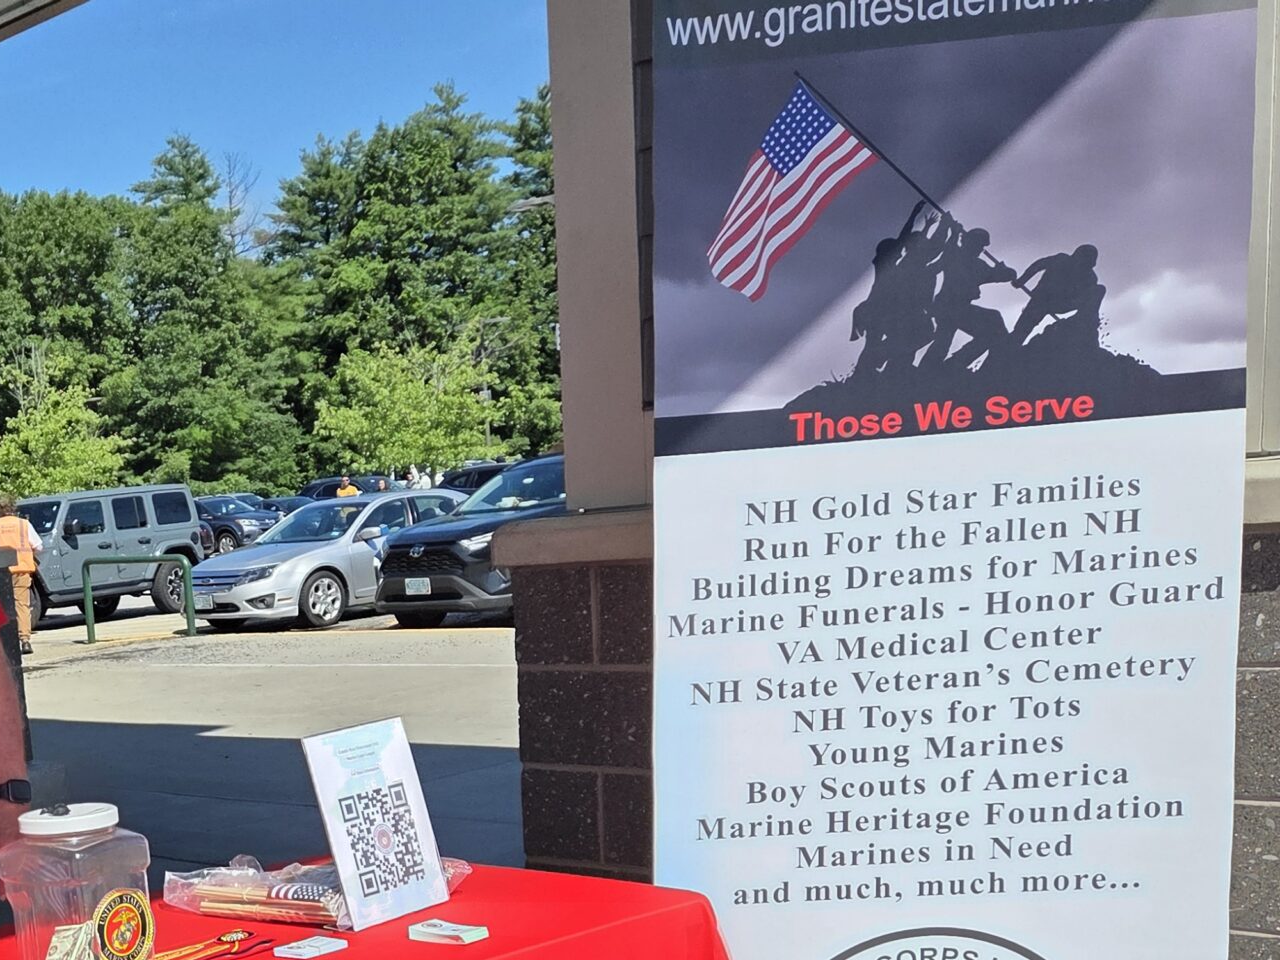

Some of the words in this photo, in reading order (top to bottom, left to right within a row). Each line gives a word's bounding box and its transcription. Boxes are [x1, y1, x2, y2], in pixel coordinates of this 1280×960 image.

[666, 0, 1111, 47] www.granitestate
[789, 408, 903, 443] Those
[914, 400, 976, 433] We
[984, 395, 1095, 428] Serve
[745, 499, 797, 526] NH
[812, 492, 890, 521] Gold
[906, 489, 978, 514] Star
[992, 474, 1141, 507] Families
[744, 538, 809, 562] Run
[824, 531, 882, 556] For
[895, 525, 946, 550] the
[961, 517, 1068, 546] Fallen
[1084, 508, 1141, 536] NH
[693, 570, 831, 601] Building
[845, 564, 972, 590] Dreams
[987, 555, 1038, 580] for
[1052, 545, 1197, 575] Marines
[668, 609, 784, 638] Marine
[798, 596, 944, 629] Funerals
[985, 590, 1095, 616] Honor
[1109, 575, 1225, 607] Guard
[776, 640, 824, 665] VA
[835, 629, 969, 661] Medical
[983, 625, 1102, 651] Center
[691, 680, 741, 706] NH
[756, 676, 838, 701] State
[851, 663, 1010, 694] Veteran’s
[1025, 656, 1196, 684] Cemetery
[793, 707, 845, 733] NH
[859, 705, 933, 733] Toys
[947, 700, 997, 724] for
[1010, 696, 1081, 720] Tots
[808, 743, 910, 768] Young
[924, 732, 1063, 760] Marines
[747, 781, 807, 808] Boy
[820, 774, 926, 800] Scouts
[940, 769, 975, 793] of
[983, 763, 1129, 791] America
[696, 814, 812, 841] Marine
[826, 807, 970, 835] Heritage
[985, 795, 1183, 826] Foundation
[796, 842, 930, 869] Marines
[945, 838, 974, 862] in
[989, 834, 1073, 860] Need
[99, 899, 121, 925] UNITED
[122, 895, 144, 914] STATES
[733, 881, 790, 905] and
[805, 876, 902, 902] much,
[917, 871, 1005, 897] much
[1022, 873, 1140, 893] more...
[129, 936, 145, 960] CORPS
